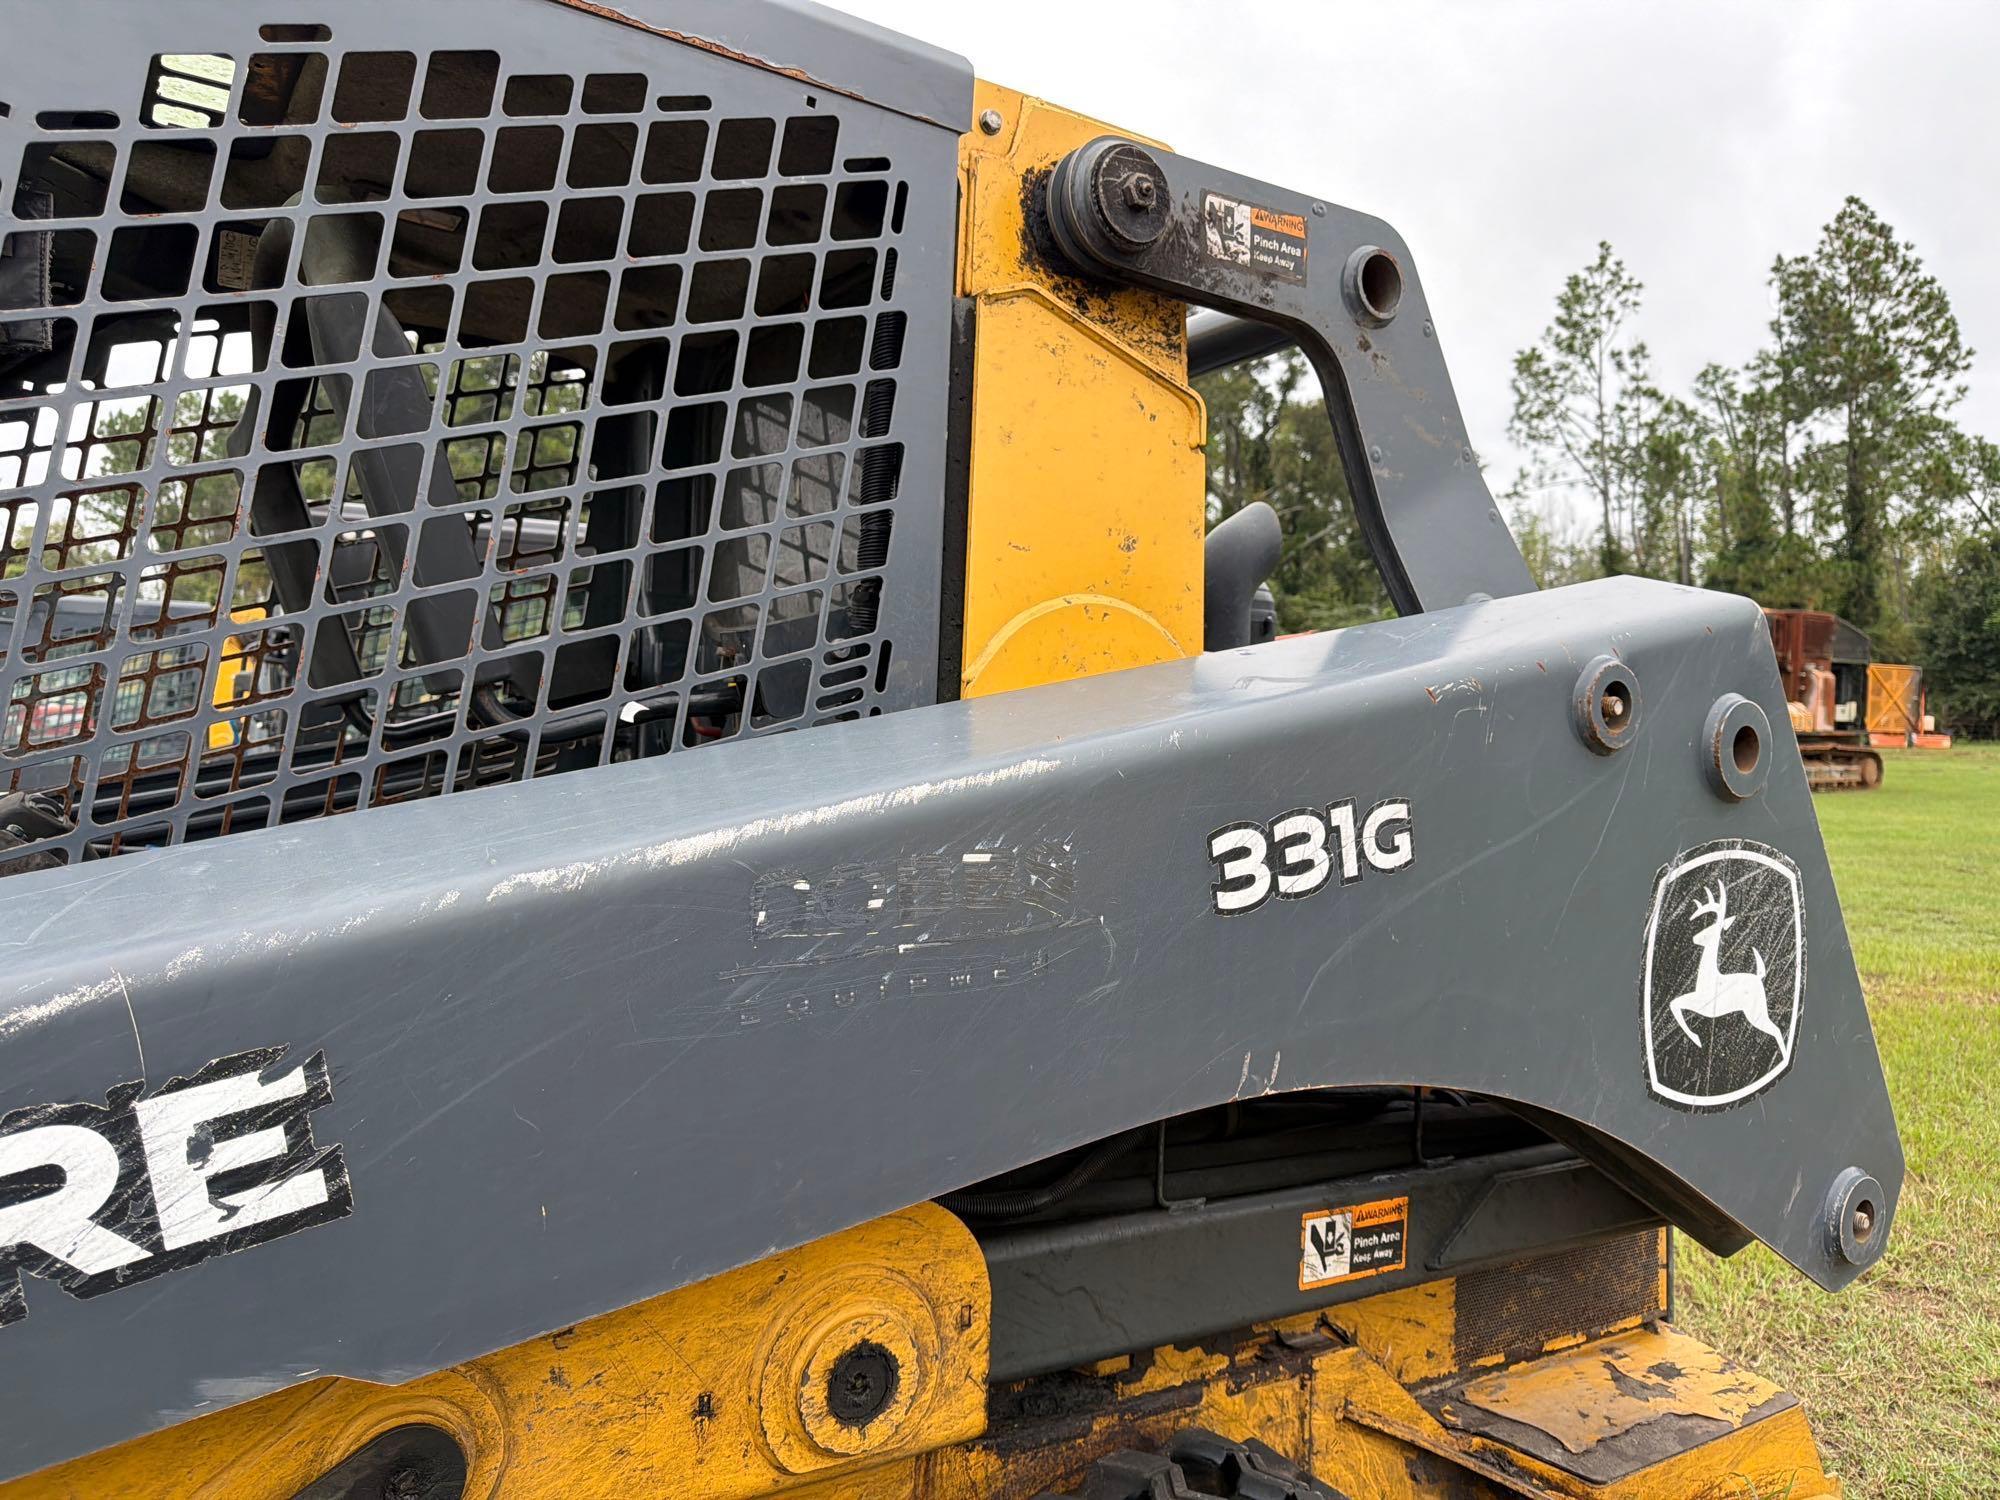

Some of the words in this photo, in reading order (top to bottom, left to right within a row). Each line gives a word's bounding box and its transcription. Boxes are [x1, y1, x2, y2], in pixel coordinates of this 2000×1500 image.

[1263, 213, 1303, 232] WARNING
[1253, 234, 1279, 251] Pinch
[1280, 242, 1302, 257] Area
[1253, 249, 1273, 264] Keep
[1274, 255, 1295, 271] Away
[1211, 803, 1413, 910] 331G
[1364, 1203, 1403, 1220] WARNING
[1354, 1234, 1379, 1249] Pinch
[1380, 1232, 1401, 1244] Area
[1373, 1248, 1394, 1260] Away
